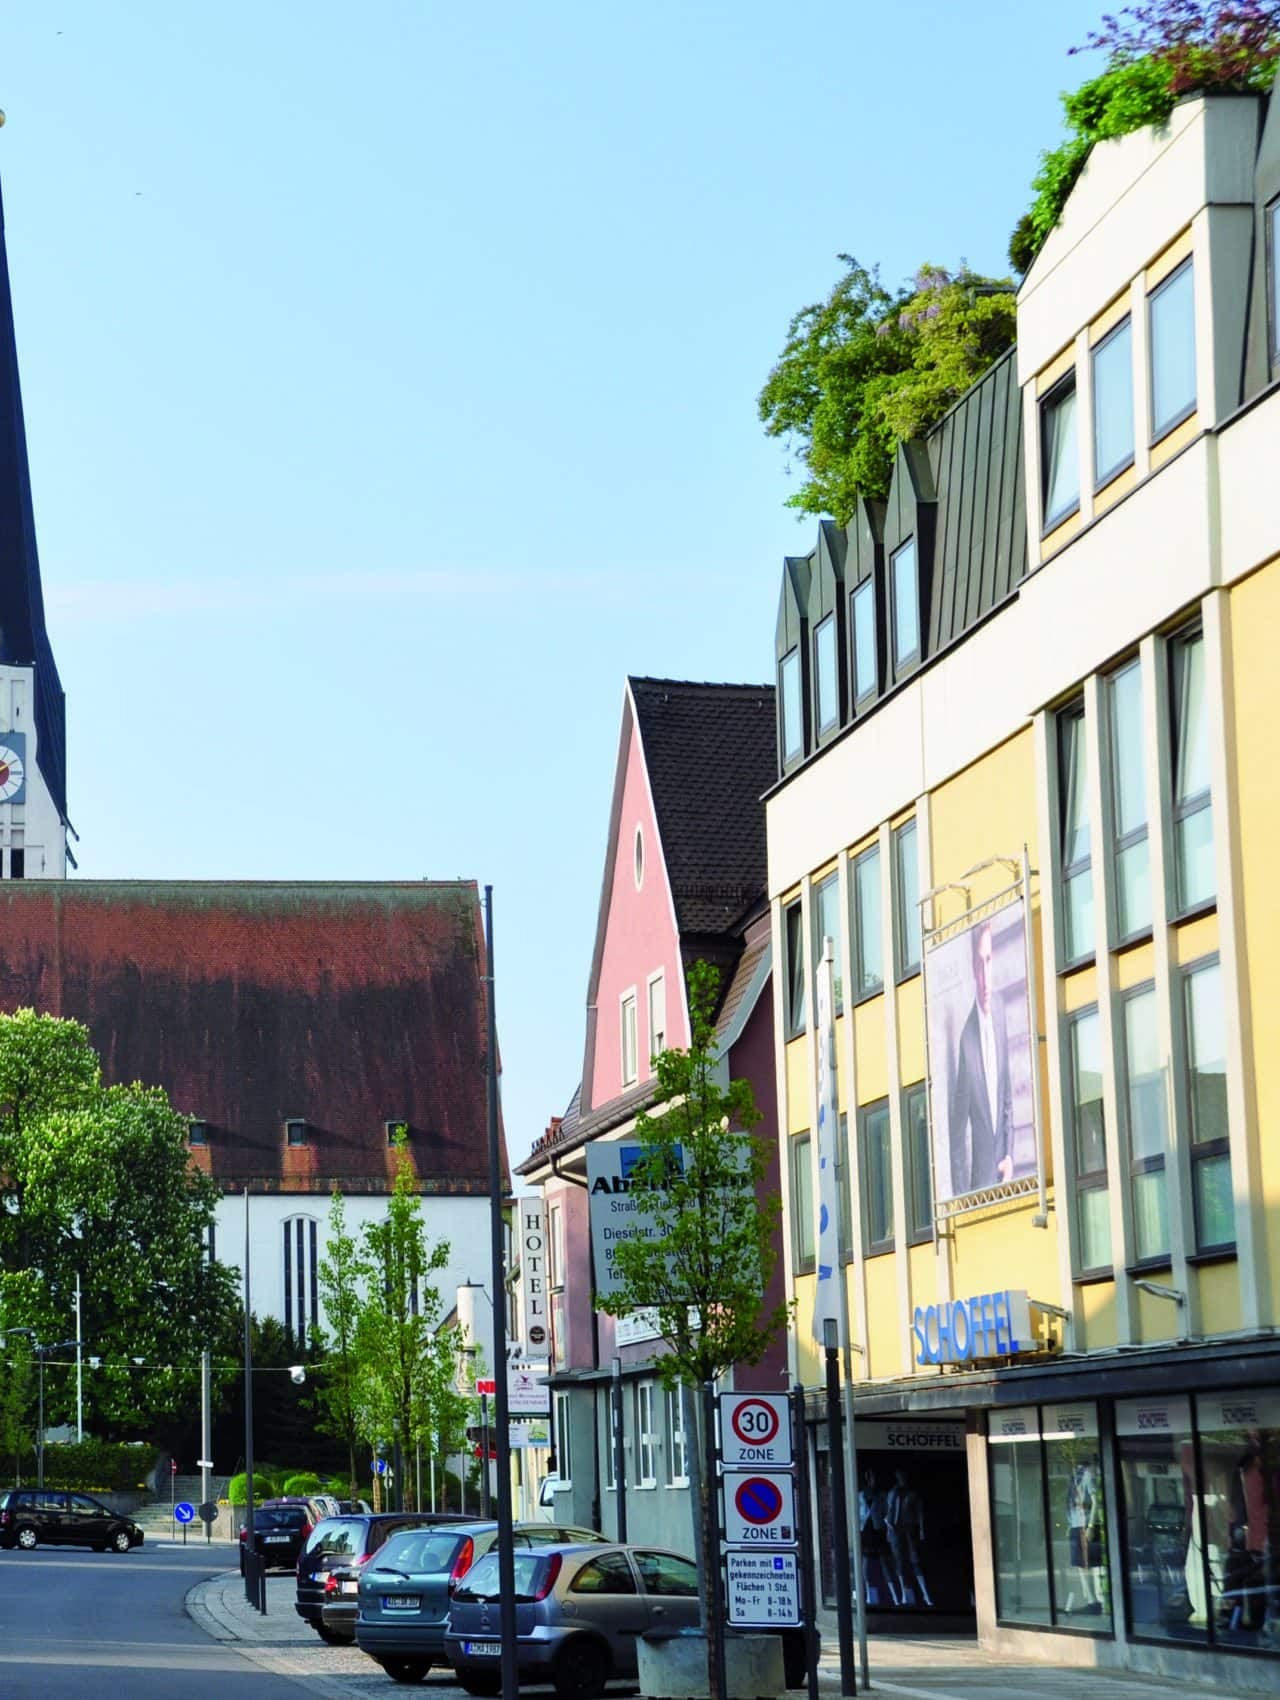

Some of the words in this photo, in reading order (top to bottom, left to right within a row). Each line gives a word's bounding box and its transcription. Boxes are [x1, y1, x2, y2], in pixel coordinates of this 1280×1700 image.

[526, 1214, 543, 1315] HOTEL
[742, 1411, 769, 1432] 30
[739, 1448, 775, 1460] ZONE
[743, 1527, 778, 1540] ZONE
[731, 1558, 757, 1567] Parken
[760, 1558, 772, 1567] mit
[785, 1559, 793, 1567] in
[729, 1570, 795, 1581] gekennzeichneten
[736, 1582, 765, 1592] Flächen
[735, 1608, 745, 1617] Sa
